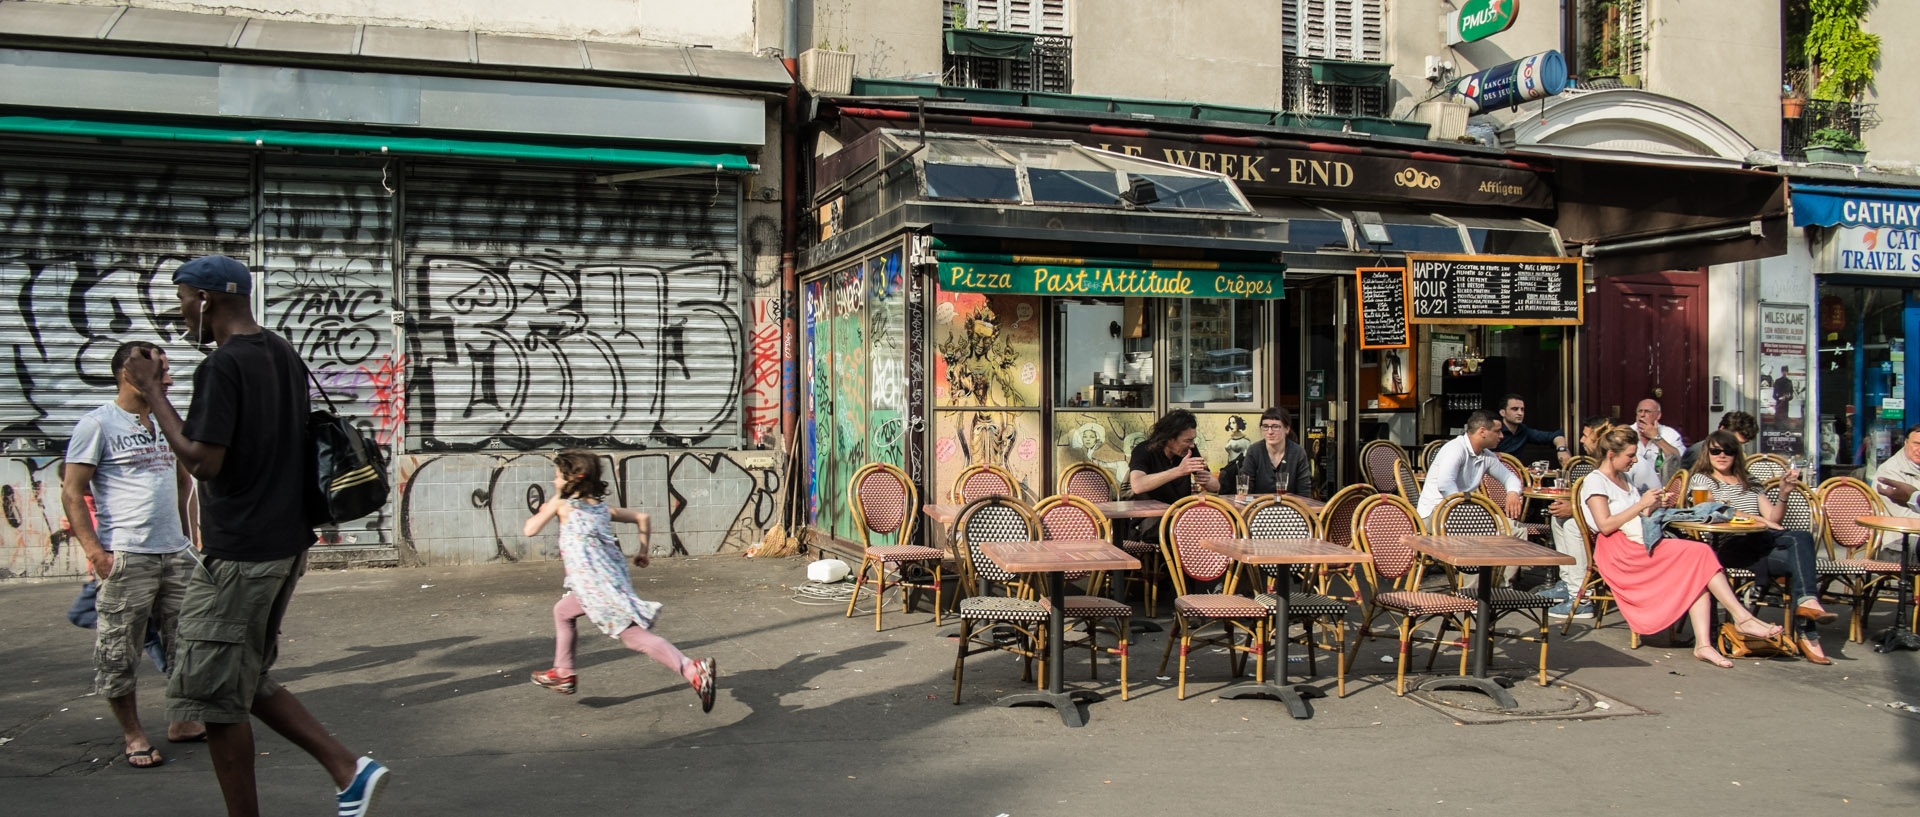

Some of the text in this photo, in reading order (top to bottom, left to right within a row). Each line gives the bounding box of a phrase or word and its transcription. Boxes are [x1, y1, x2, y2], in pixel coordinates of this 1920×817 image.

[1462, 8, 1489, 32] PMU
[1483, 92, 1497, 101] DES
[1394, 167, 1441, 190] LOTO
[1478, 180, 1523, 196] Affligem
[1843, 200, 1920, 226] CATHAY
[1842, 250, 1906, 271] TRAVEL
[1413, 262, 1452, 279] HAPPY
[951, 266, 1012, 289] Pizza
[1214, 274, 1273, 299] Crêpes
[1413, 281, 1448, 298] HOUR
[1413, 299, 1448, 315] 18/21
[1764, 311, 1804, 325] MILES KANE
